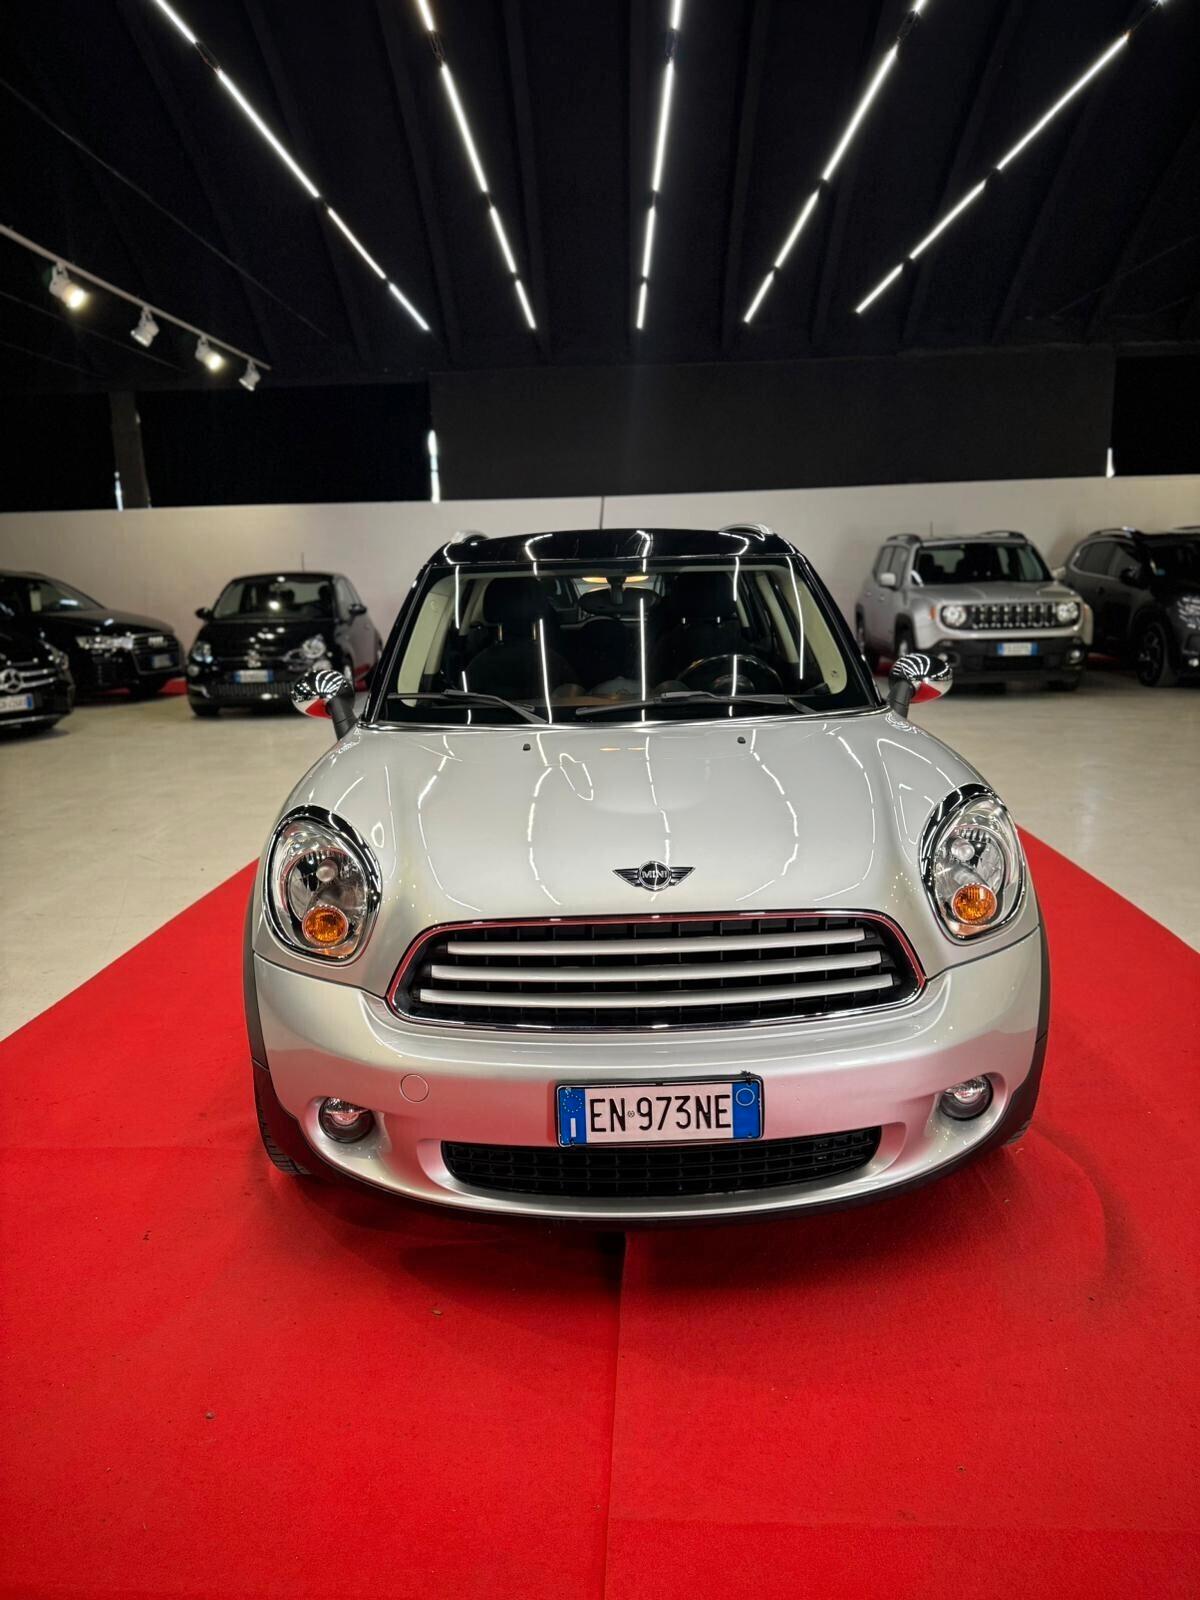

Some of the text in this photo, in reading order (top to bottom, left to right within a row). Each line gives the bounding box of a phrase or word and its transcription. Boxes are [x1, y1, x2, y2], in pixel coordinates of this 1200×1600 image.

[641, 870, 668, 879] MINI
[589, 1094, 732, 1133] EN 973NE
